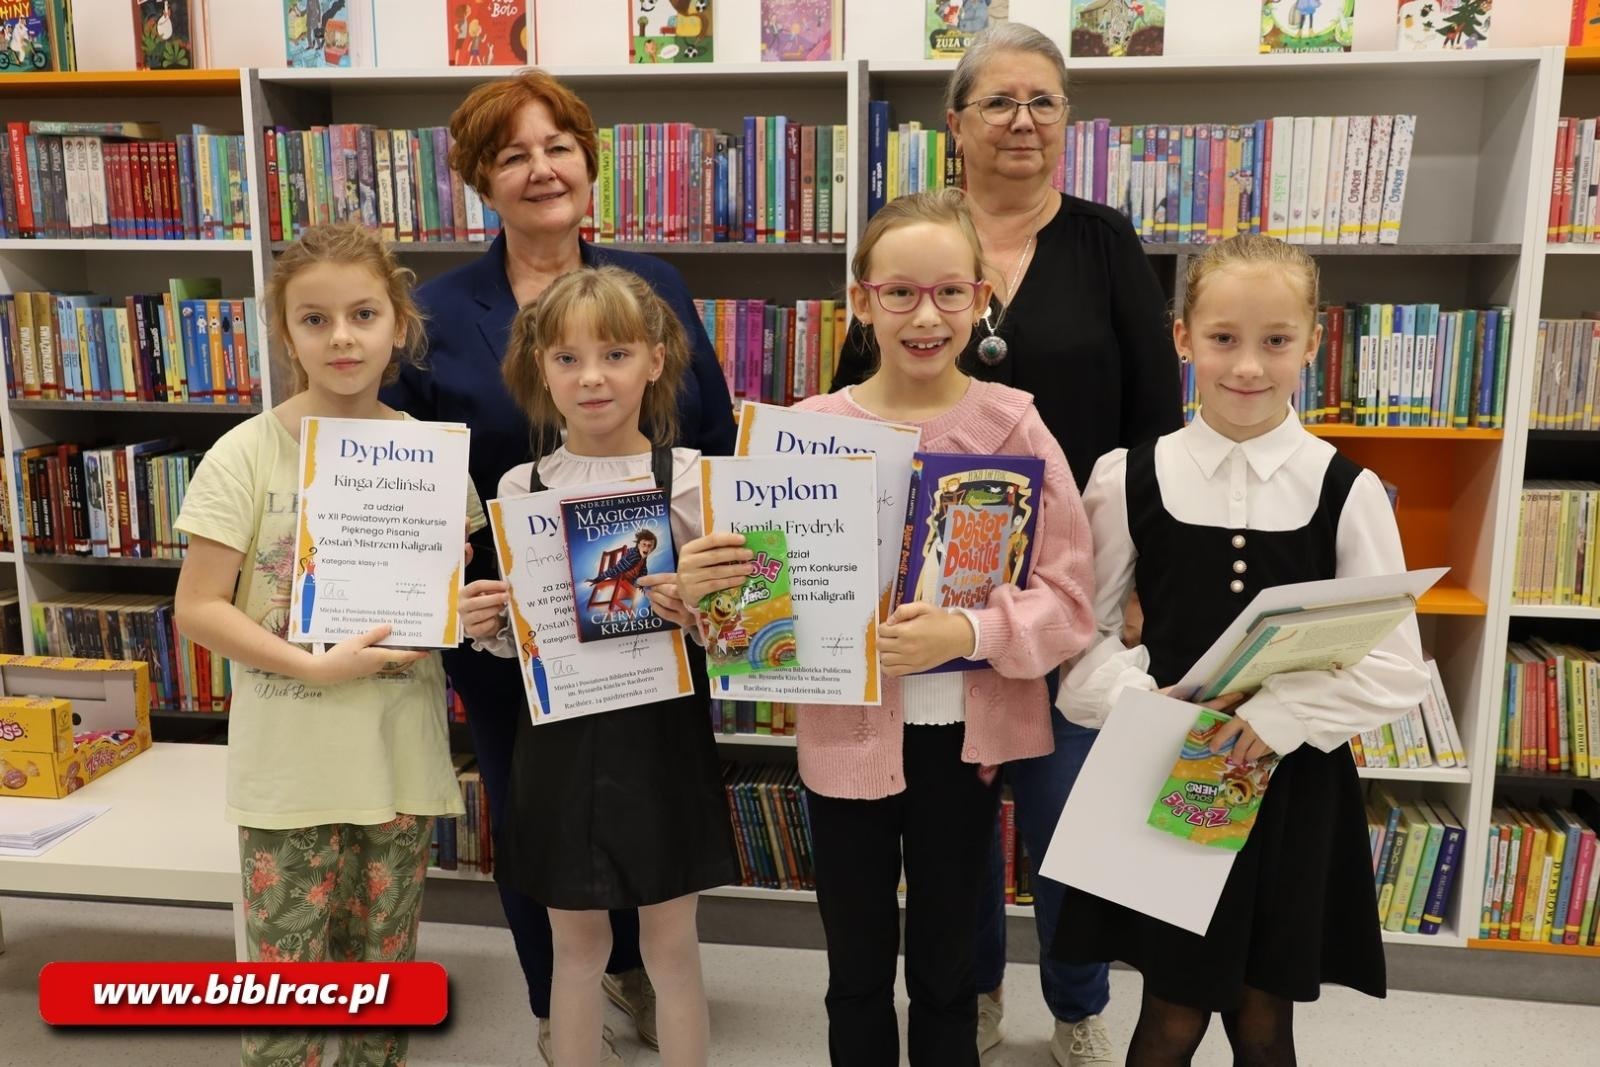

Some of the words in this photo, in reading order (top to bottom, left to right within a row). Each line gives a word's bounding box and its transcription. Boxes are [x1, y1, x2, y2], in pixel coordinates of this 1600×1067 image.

[491, 2, 518, 17] Bolo
[936, 38, 962, 50] ZUZA
[1553, 167, 1562, 195] INNA?
[1564, 167, 1574, 195] INNA?
[819, 189, 830, 232] SANDERSON
[340, 438, 434, 466] Dyplom
[334, 475, 372, 491] Kinga
[376, 476, 436, 492] Zielińska
[736, 476, 838, 508] Dyplom
[376, 502, 404, 512] udział
[575, 500, 614, 510] ANDRZEJ
[618, 493, 664, 504] MALESZKA
[341, 514, 400, 525] Powiatowym
[403, 517, 447, 526] Konkursie
[575, 504, 666, 530] MAGICZNE
[342, 526, 384, 537] Pięknego
[386, 527, 420, 537] Pisania
[585, 518, 658, 542] DRZEWO
[730, 520, 782, 534] Kamila
[786, 518, 845, 537] Frydryk
[952, 509, 1009, 549] Doktor
[318, 537, 352, 547] Zostań
[355, 539, 399, 549] Mistrzem
[401, 540, 443, 552] Kaligrafii
[524, 544, 570, 578] Amel
[786, 550, 810, 559] dział
[943, 540, 1000, 577] Dolittle
[358, 559, 375, 568] klasy
[809, 563, 857, 572] Konkursie
[542, 584, 553, 593] za
[793, 578, 829, 586] Pisania
[537, 596, 549, 606] XII
[811, 590, 855, 604] Kaligrafii
[590, 607, 654, 625] CZERWO
[600, 617, 663, 636] KRZESŁO
[1185, 783, 1219, 796] HERO
